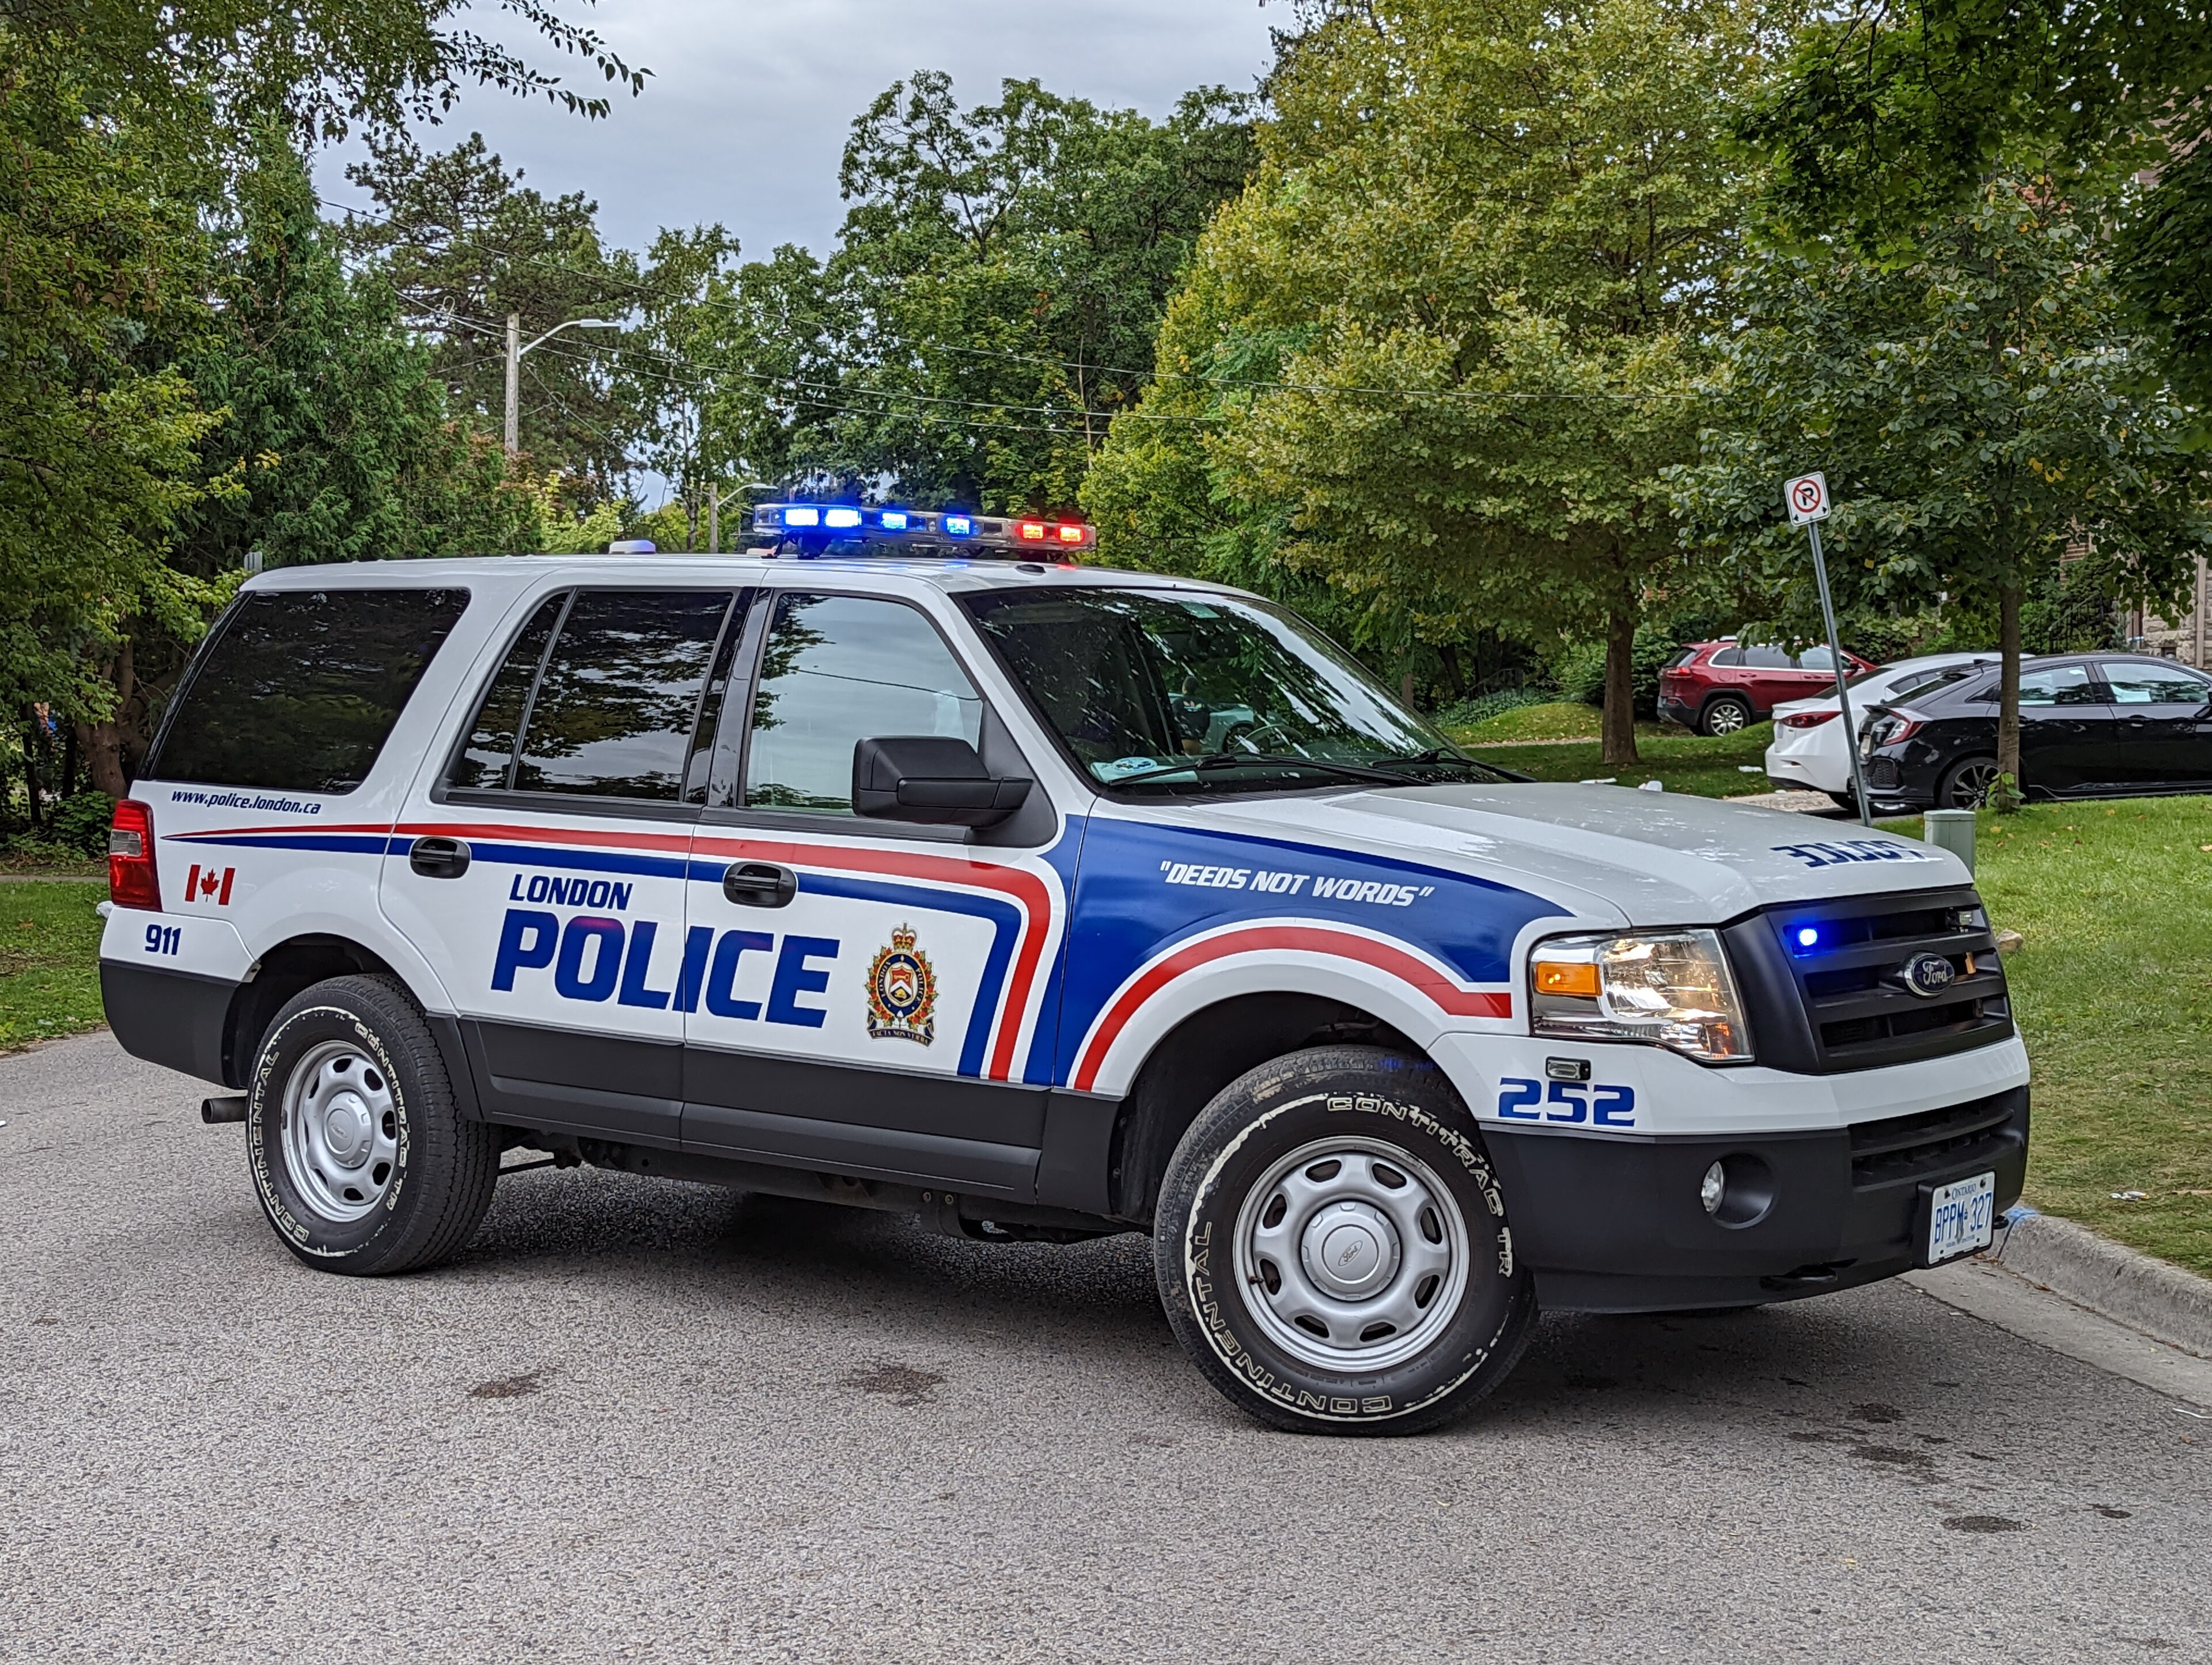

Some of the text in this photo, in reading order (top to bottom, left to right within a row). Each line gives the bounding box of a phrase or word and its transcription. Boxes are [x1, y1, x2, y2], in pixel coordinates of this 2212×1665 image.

[172, 790, 321, 814] www.police.london.ca
[509, 874, 632, 911] LONDON
[1249, 870, 1310, 895] NOT
[145, 924, 181, 956] 911
[491, 908, 841, 1029] POLICE
[1922, 961, 1953, 985] Ford
[1498, 1078, 1635, 1127] 252
[253, 1051, 309, 1242] CONTINENTAL
[1327, 1097, 1513, 1278] CONTITRAC TR
[1952, 1183, 1976, 1200] ONTARIO
[1970, 1192, 1992, 1232] 327
[1194, 1221, 1393, 1413] CONTINENTAL
